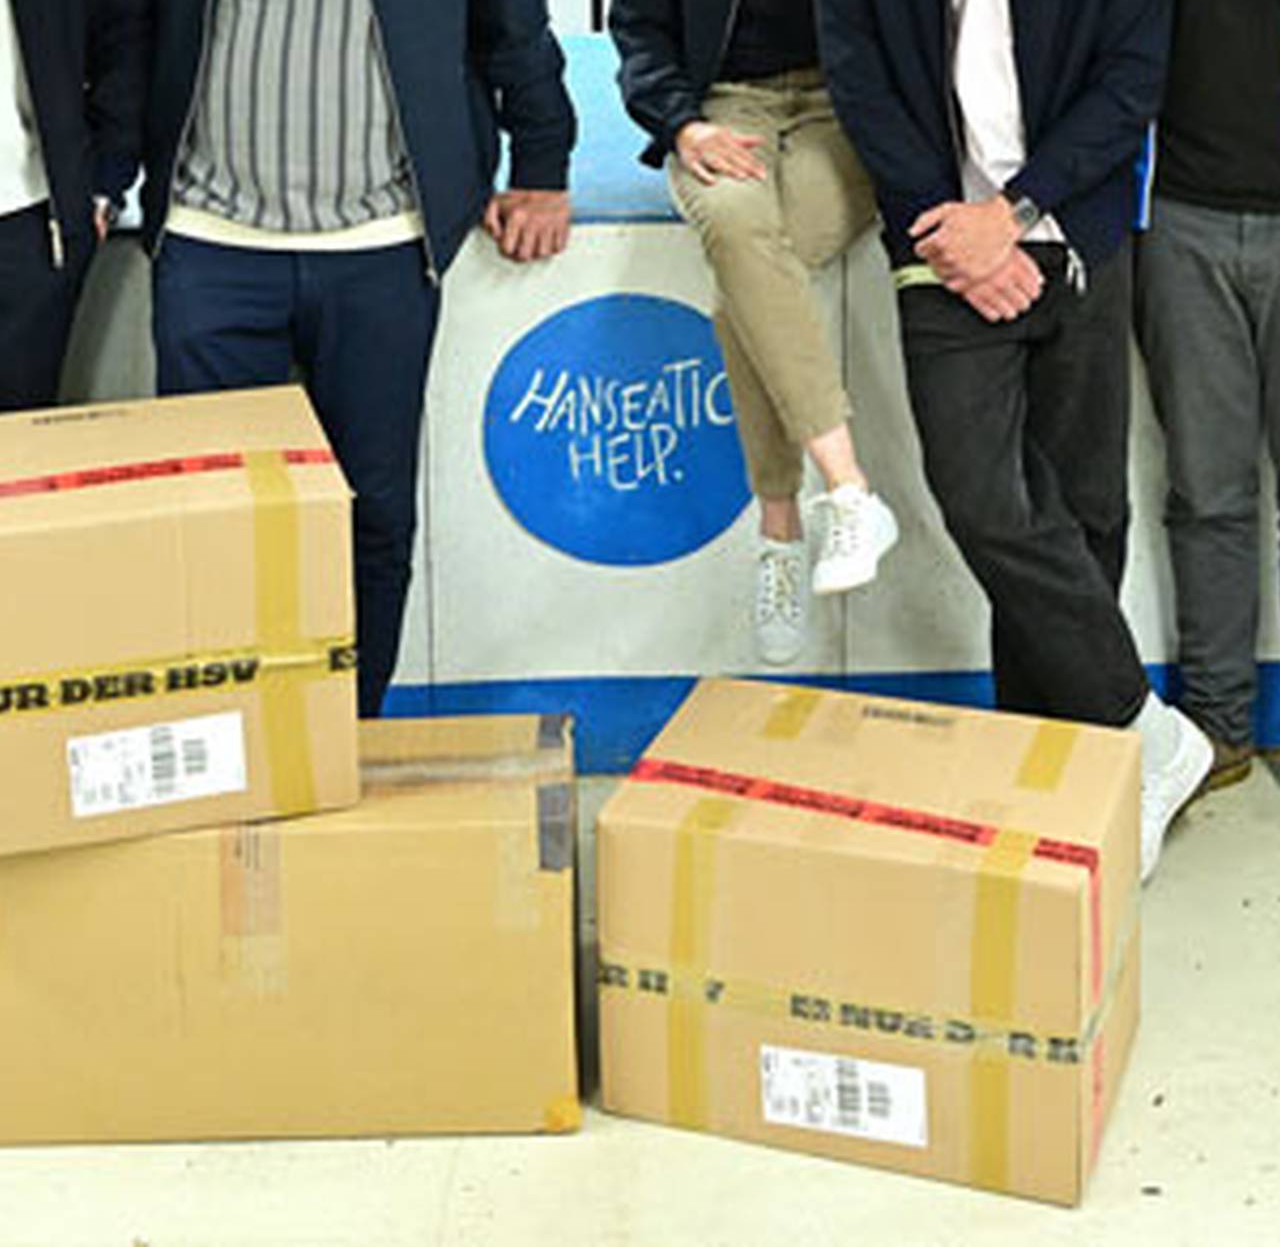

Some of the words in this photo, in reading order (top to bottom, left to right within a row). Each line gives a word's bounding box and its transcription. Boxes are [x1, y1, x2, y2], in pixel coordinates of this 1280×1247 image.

[509, 358, 734, 436] HANSEATIC
[569, 413, 684, 490] HELP.
[59, 670, 154, 706] DER
[164, 657, 260, 692] HSV
